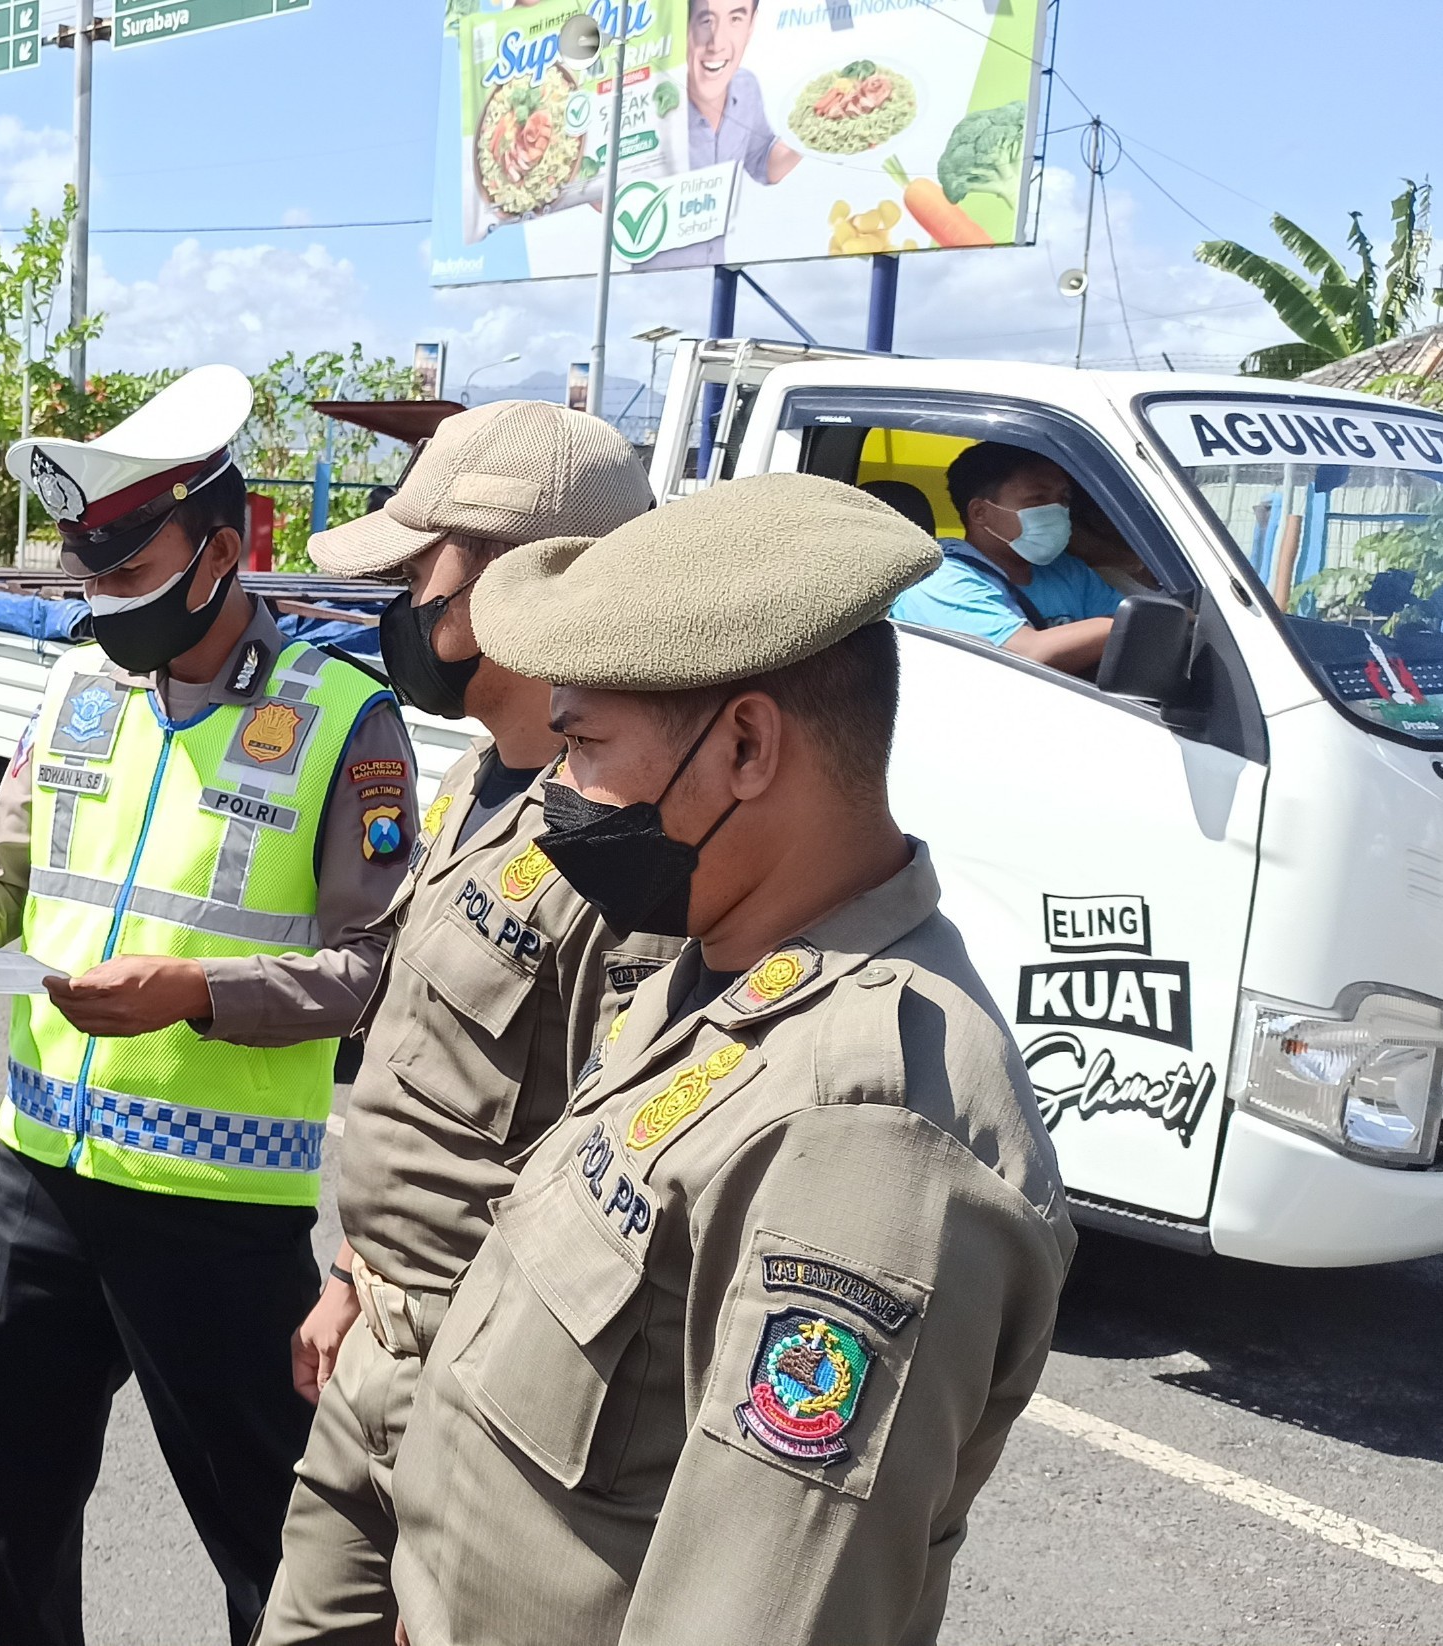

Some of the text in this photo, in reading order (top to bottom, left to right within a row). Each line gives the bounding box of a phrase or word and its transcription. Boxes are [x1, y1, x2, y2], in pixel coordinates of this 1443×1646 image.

[121, 8, 190, 38] Surabaya
[599, 92, 650, 122] SEAK
[679, 194, 716, 218] Lebih
[1189, 411, 1377, 461] AGUNG
[352, 761, 403, 775] POLRESTA
[360, 785, 402, 799] JAWA TIMUR
[215, 793, 278, 824] POLRI
[454, 876, 541, 959] POL PP
[1053, 906, 1138, 939] ELING
[1028, 970, 1182, 1034] KUAT
[576, 1119, 615, 1200] POL
[602, 1172, 651, 1240] PP
